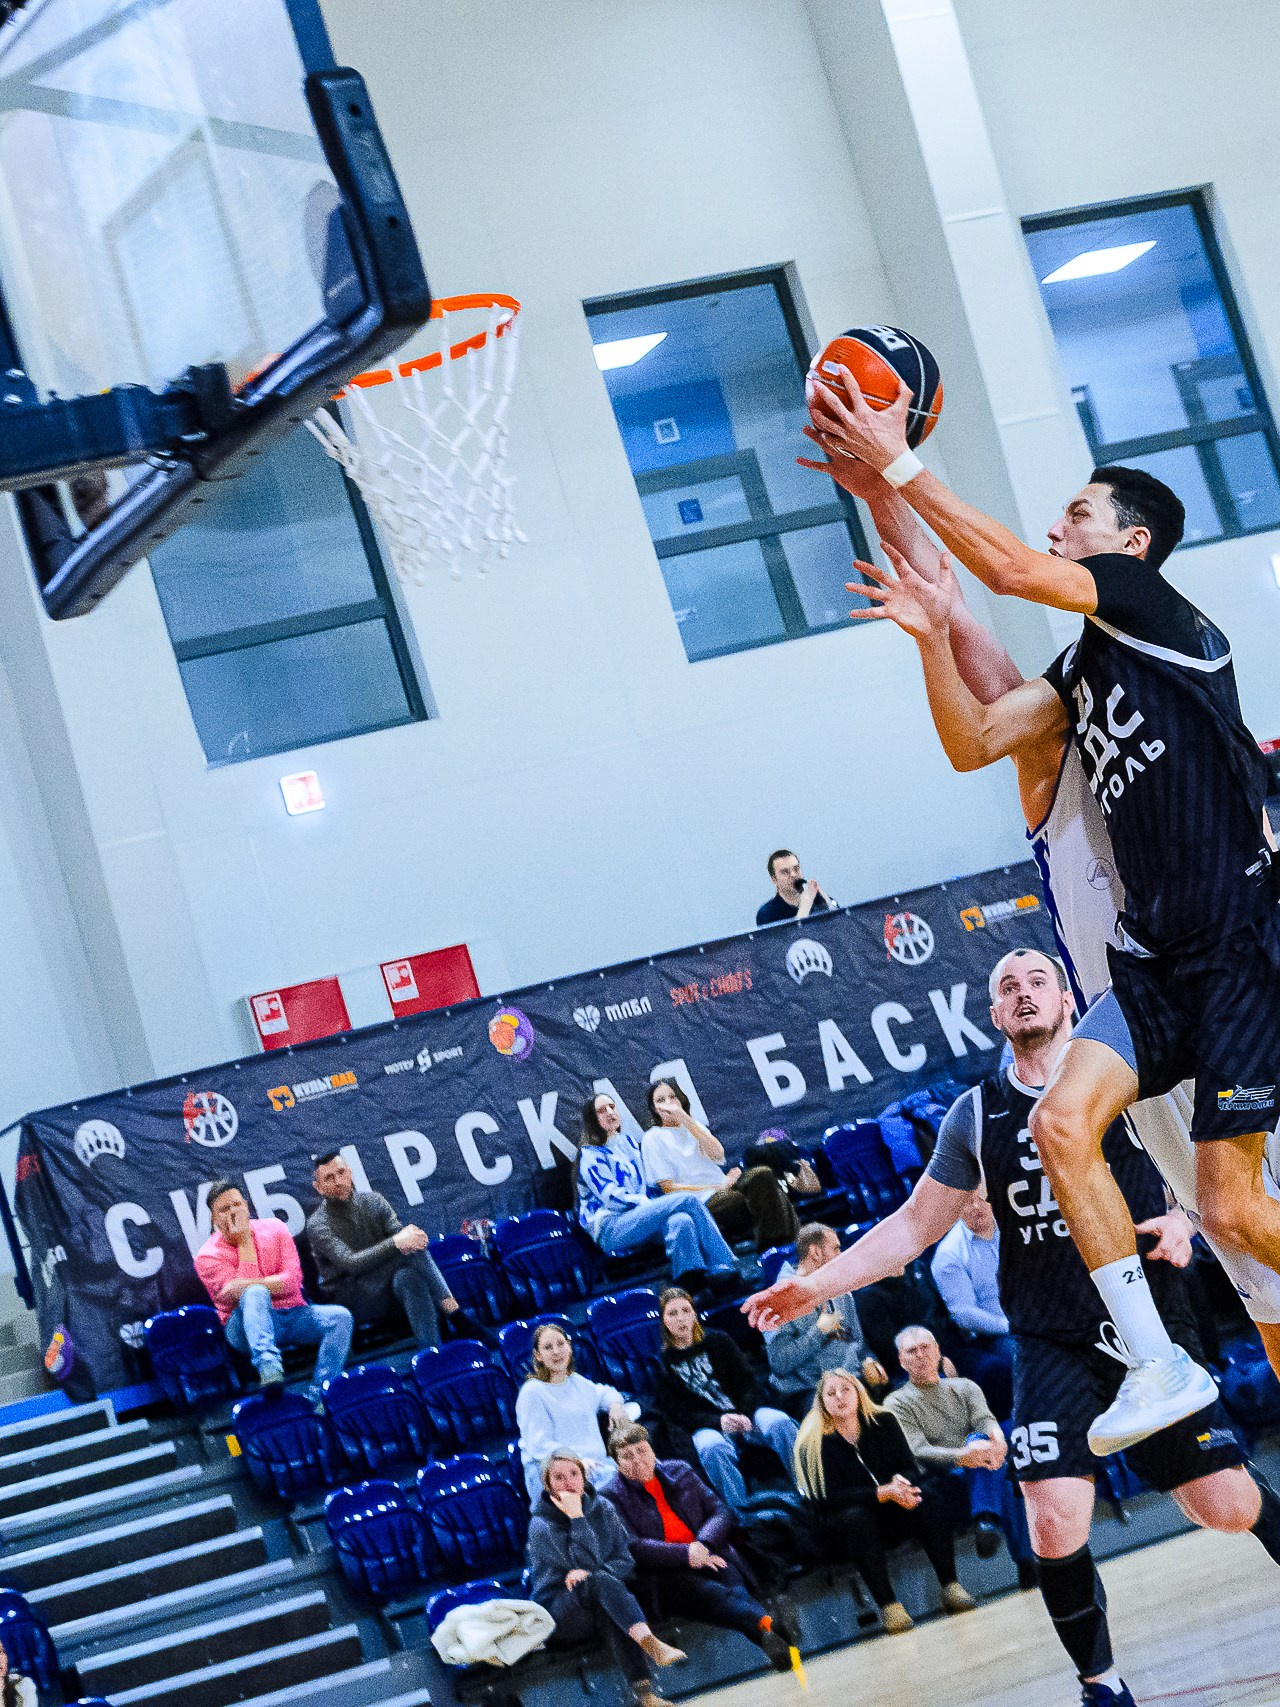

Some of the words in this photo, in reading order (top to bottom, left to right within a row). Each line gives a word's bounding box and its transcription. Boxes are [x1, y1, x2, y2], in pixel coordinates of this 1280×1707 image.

[1077, 683, 1145, 795] ДС
[1100, 739, 1166, 815] ГОЛЬ
[1007, 1175, 1060, 1218] СД
[1019, 1219, 1070, 1245] УГО
[1009, 1420, 1061, 1470] 35
